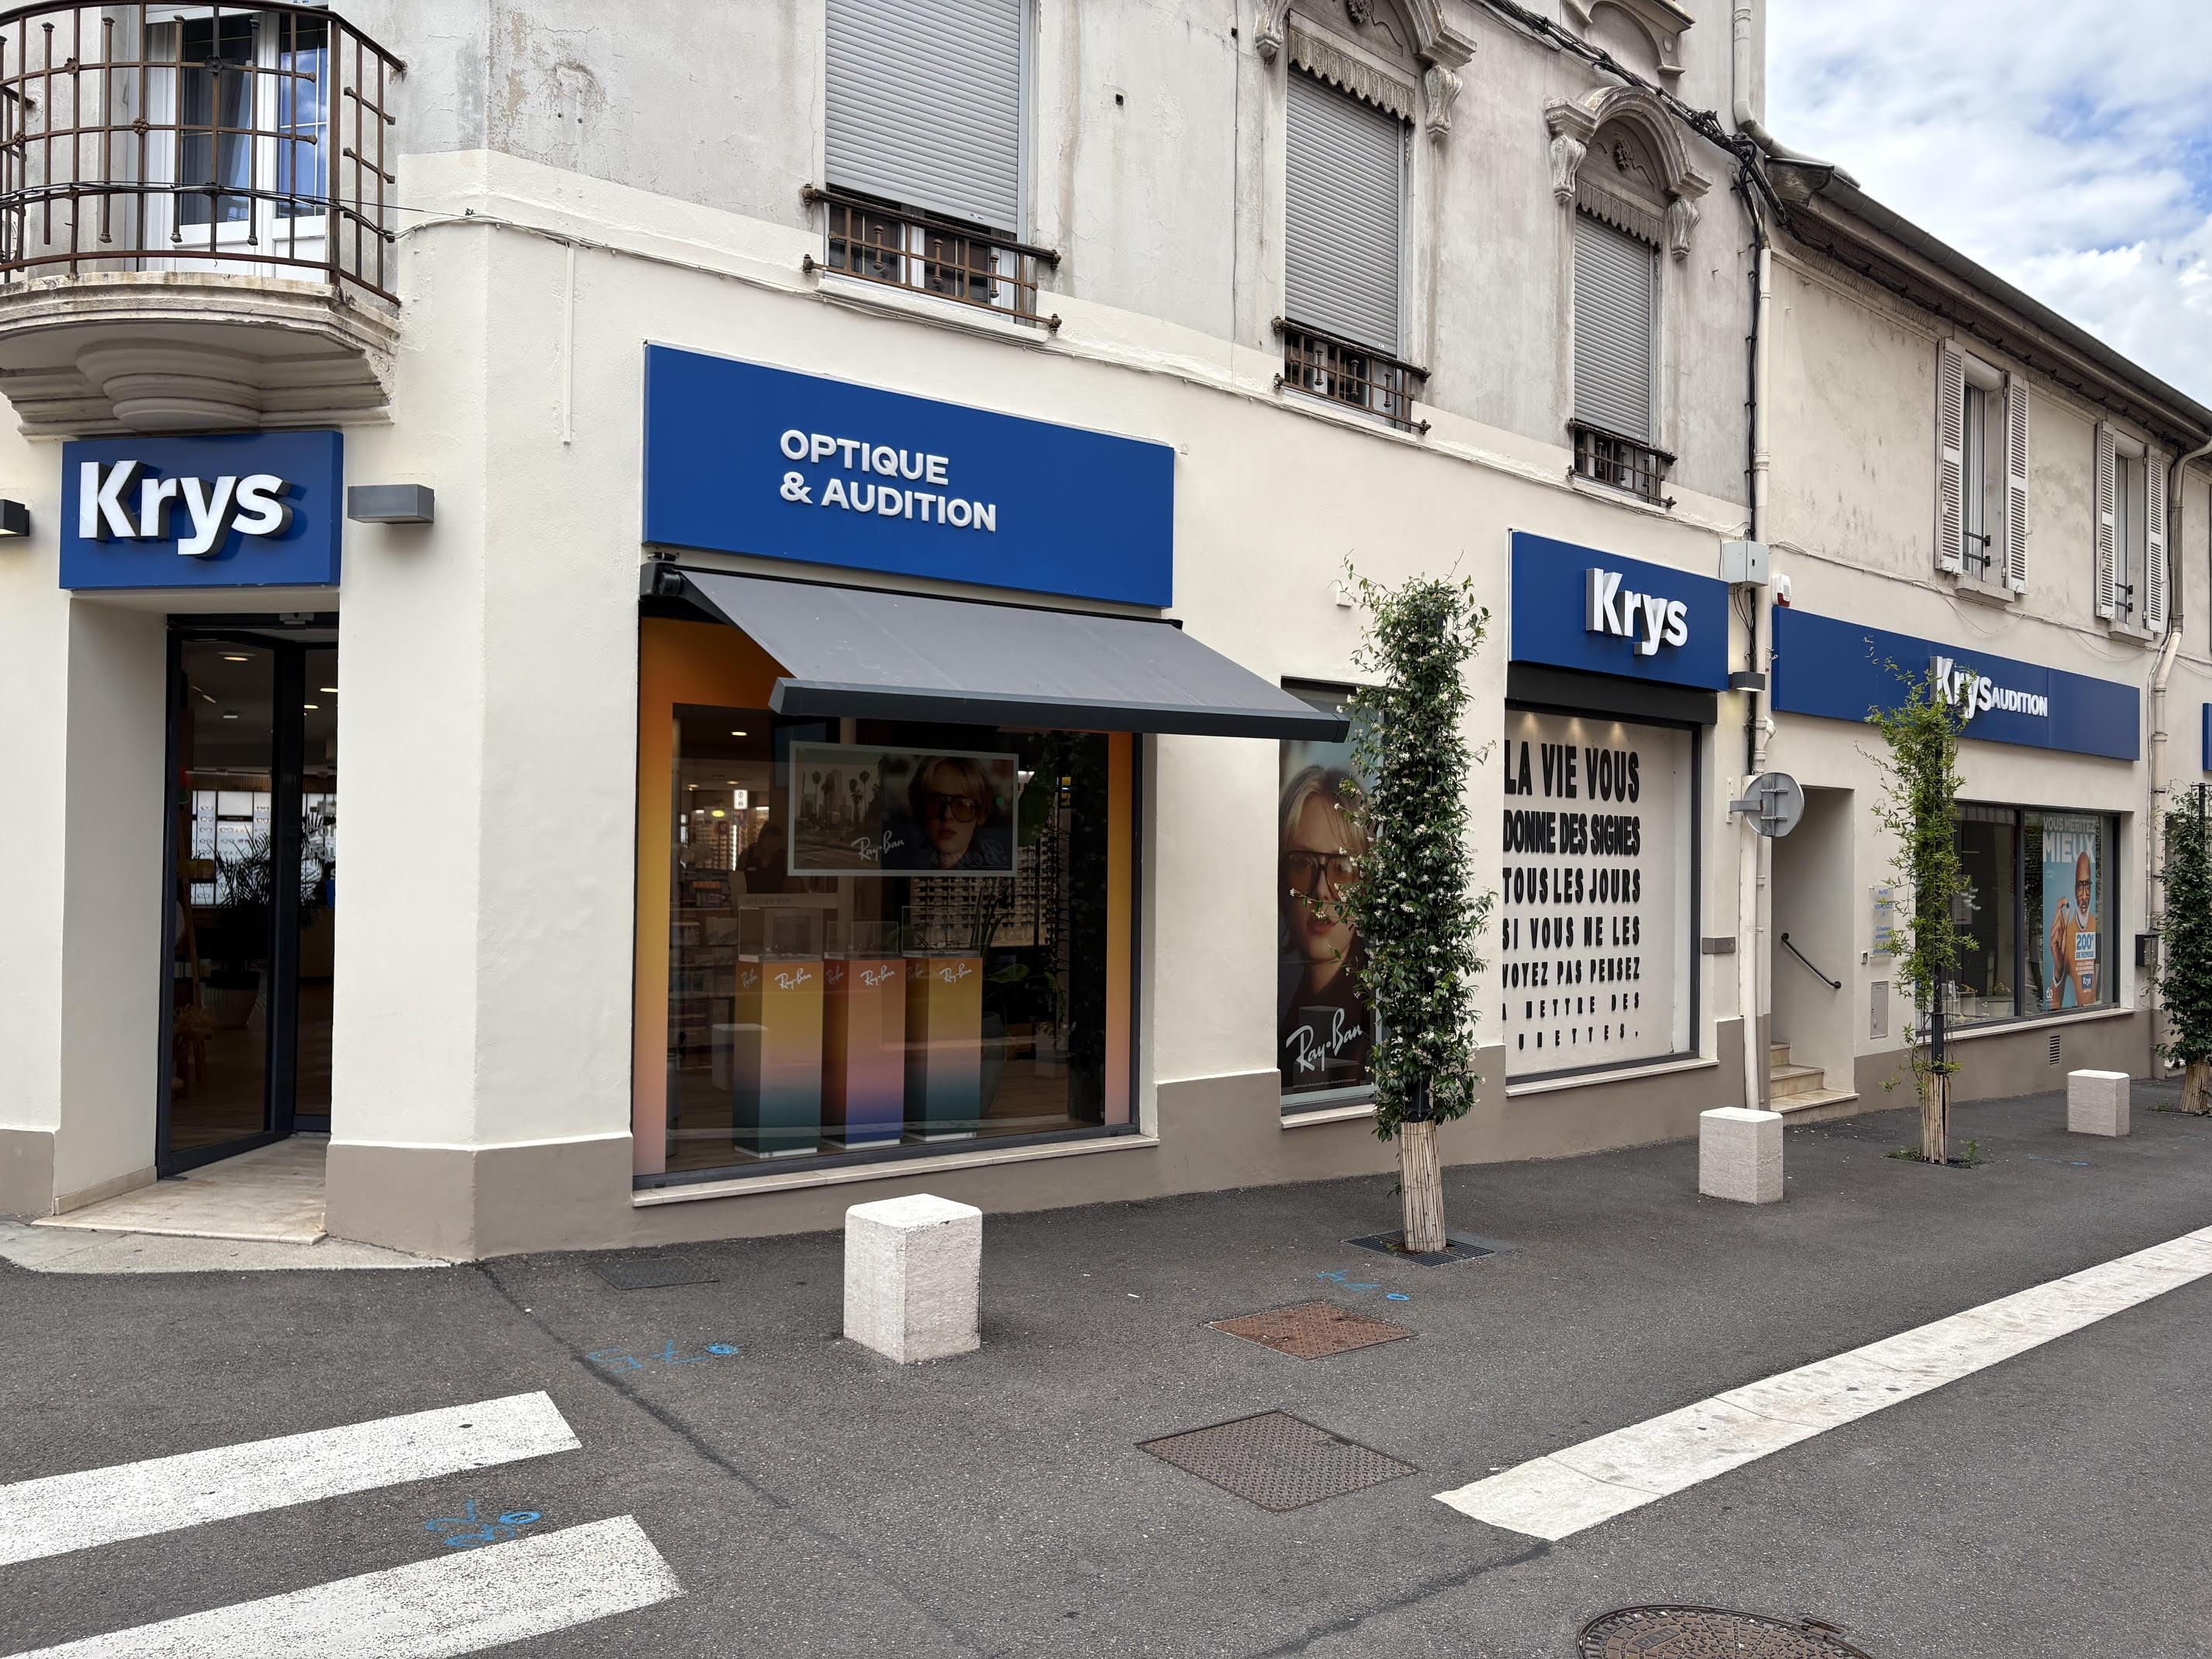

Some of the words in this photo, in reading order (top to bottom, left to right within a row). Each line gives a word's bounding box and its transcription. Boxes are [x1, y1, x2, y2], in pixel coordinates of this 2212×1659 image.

[780, 429, 949, 486] OPTIQUE
[79, 459, 287, 556] Krys
[780, 471, 813, 504] &
[821, 478, 997, 533] AUDITION
[1589, 568, 1688, 655] Krys
[1991, 687, 2049, 717] AUDITION
[1504, 740, 1533, 795] LA
[1541, 743, 1577, 799] VIE
[1585, 747, 1640, 803] VOUS
[1503, 809, 1556, 854] DONNE
[1559, 812, 1588, 855] DES
[1590, 814, 1640, 856] SIGNES
[2043, 816, 2063, 831] VOUS
[2043, 831, 2096, 864] MIEUX
[1503, 867, 1548, 904] TOUS
[1554, 867, 1584, 903] LES
[1589, 868, 1640, 903] JOURS
[1503, 918, 1518, 950] SI
[1530, 916, 1574, 949] VOUS
[1584, 916, 1603, 946] NE
[1613, 915, 1640, 946] LES
[1503, 962, 1548, 988] VOYEZ
[1558, 960, 1582, 985] PAS
[1590, 957, 1640, 983] PENSEZ
[1526, 995, 1595, 1018] METTRE
[1612, 991, 1639, 1012] DES
[1503, 1023, 1639, 1049] UNETTES.
